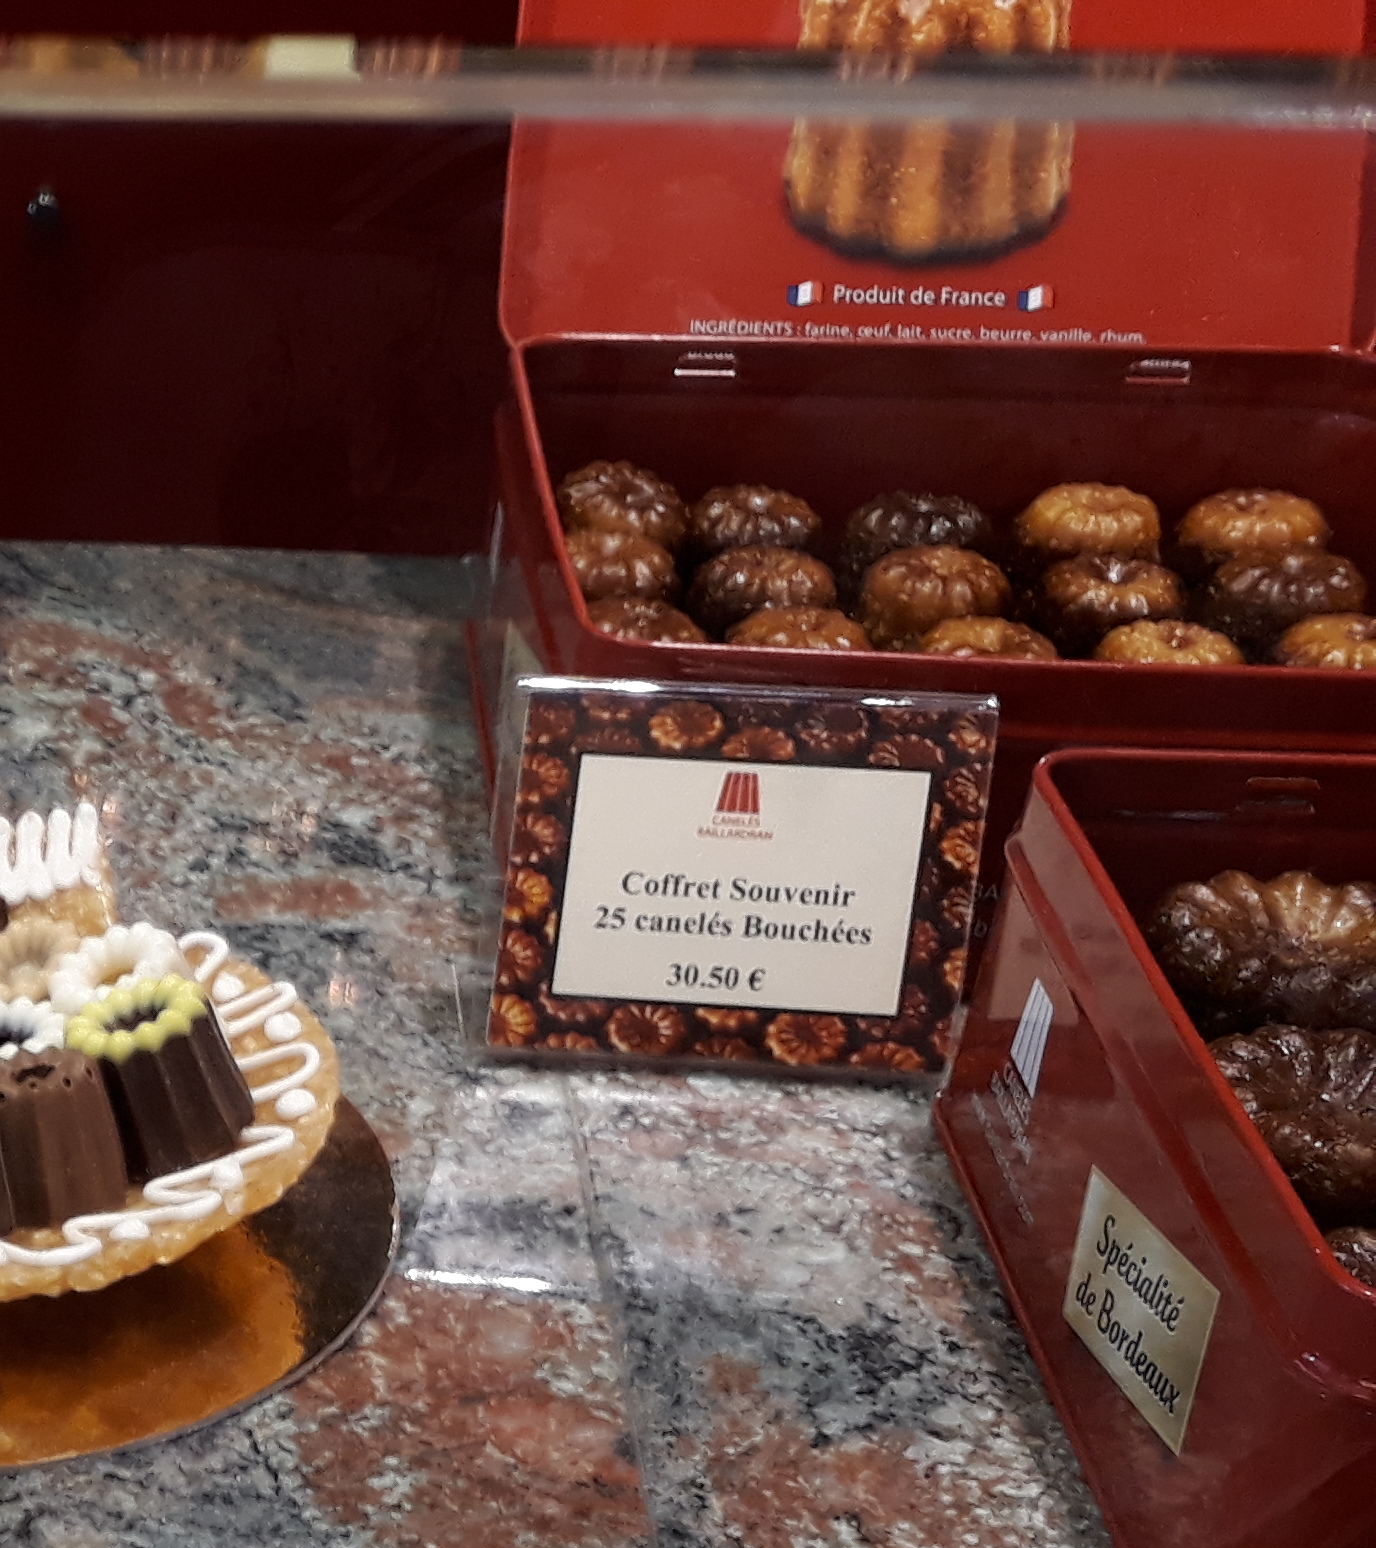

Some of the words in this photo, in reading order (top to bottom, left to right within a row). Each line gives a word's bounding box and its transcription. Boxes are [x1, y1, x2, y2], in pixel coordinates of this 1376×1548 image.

[833, 284, 905, 305] Produit
[910, 286, 935, 306] de
[940, 287, 1008, 308] France
[621, 871, 721, 900] Coffret
[729, 878, 856, 908] Souvenir
[594, 906, 627, 930] 25
[635, 912, 732, 937] canelés
[743, 914, 872, 945] Bouchées
[666, 963, 740, 991] 30.50
[748, 968, 766, 992] €
[1097, 1214, 1185, 1333] Spécialité
[1076, 1272, 1097, 1316] de
[1097, 1288, 1181, 1415] Bordeaux
